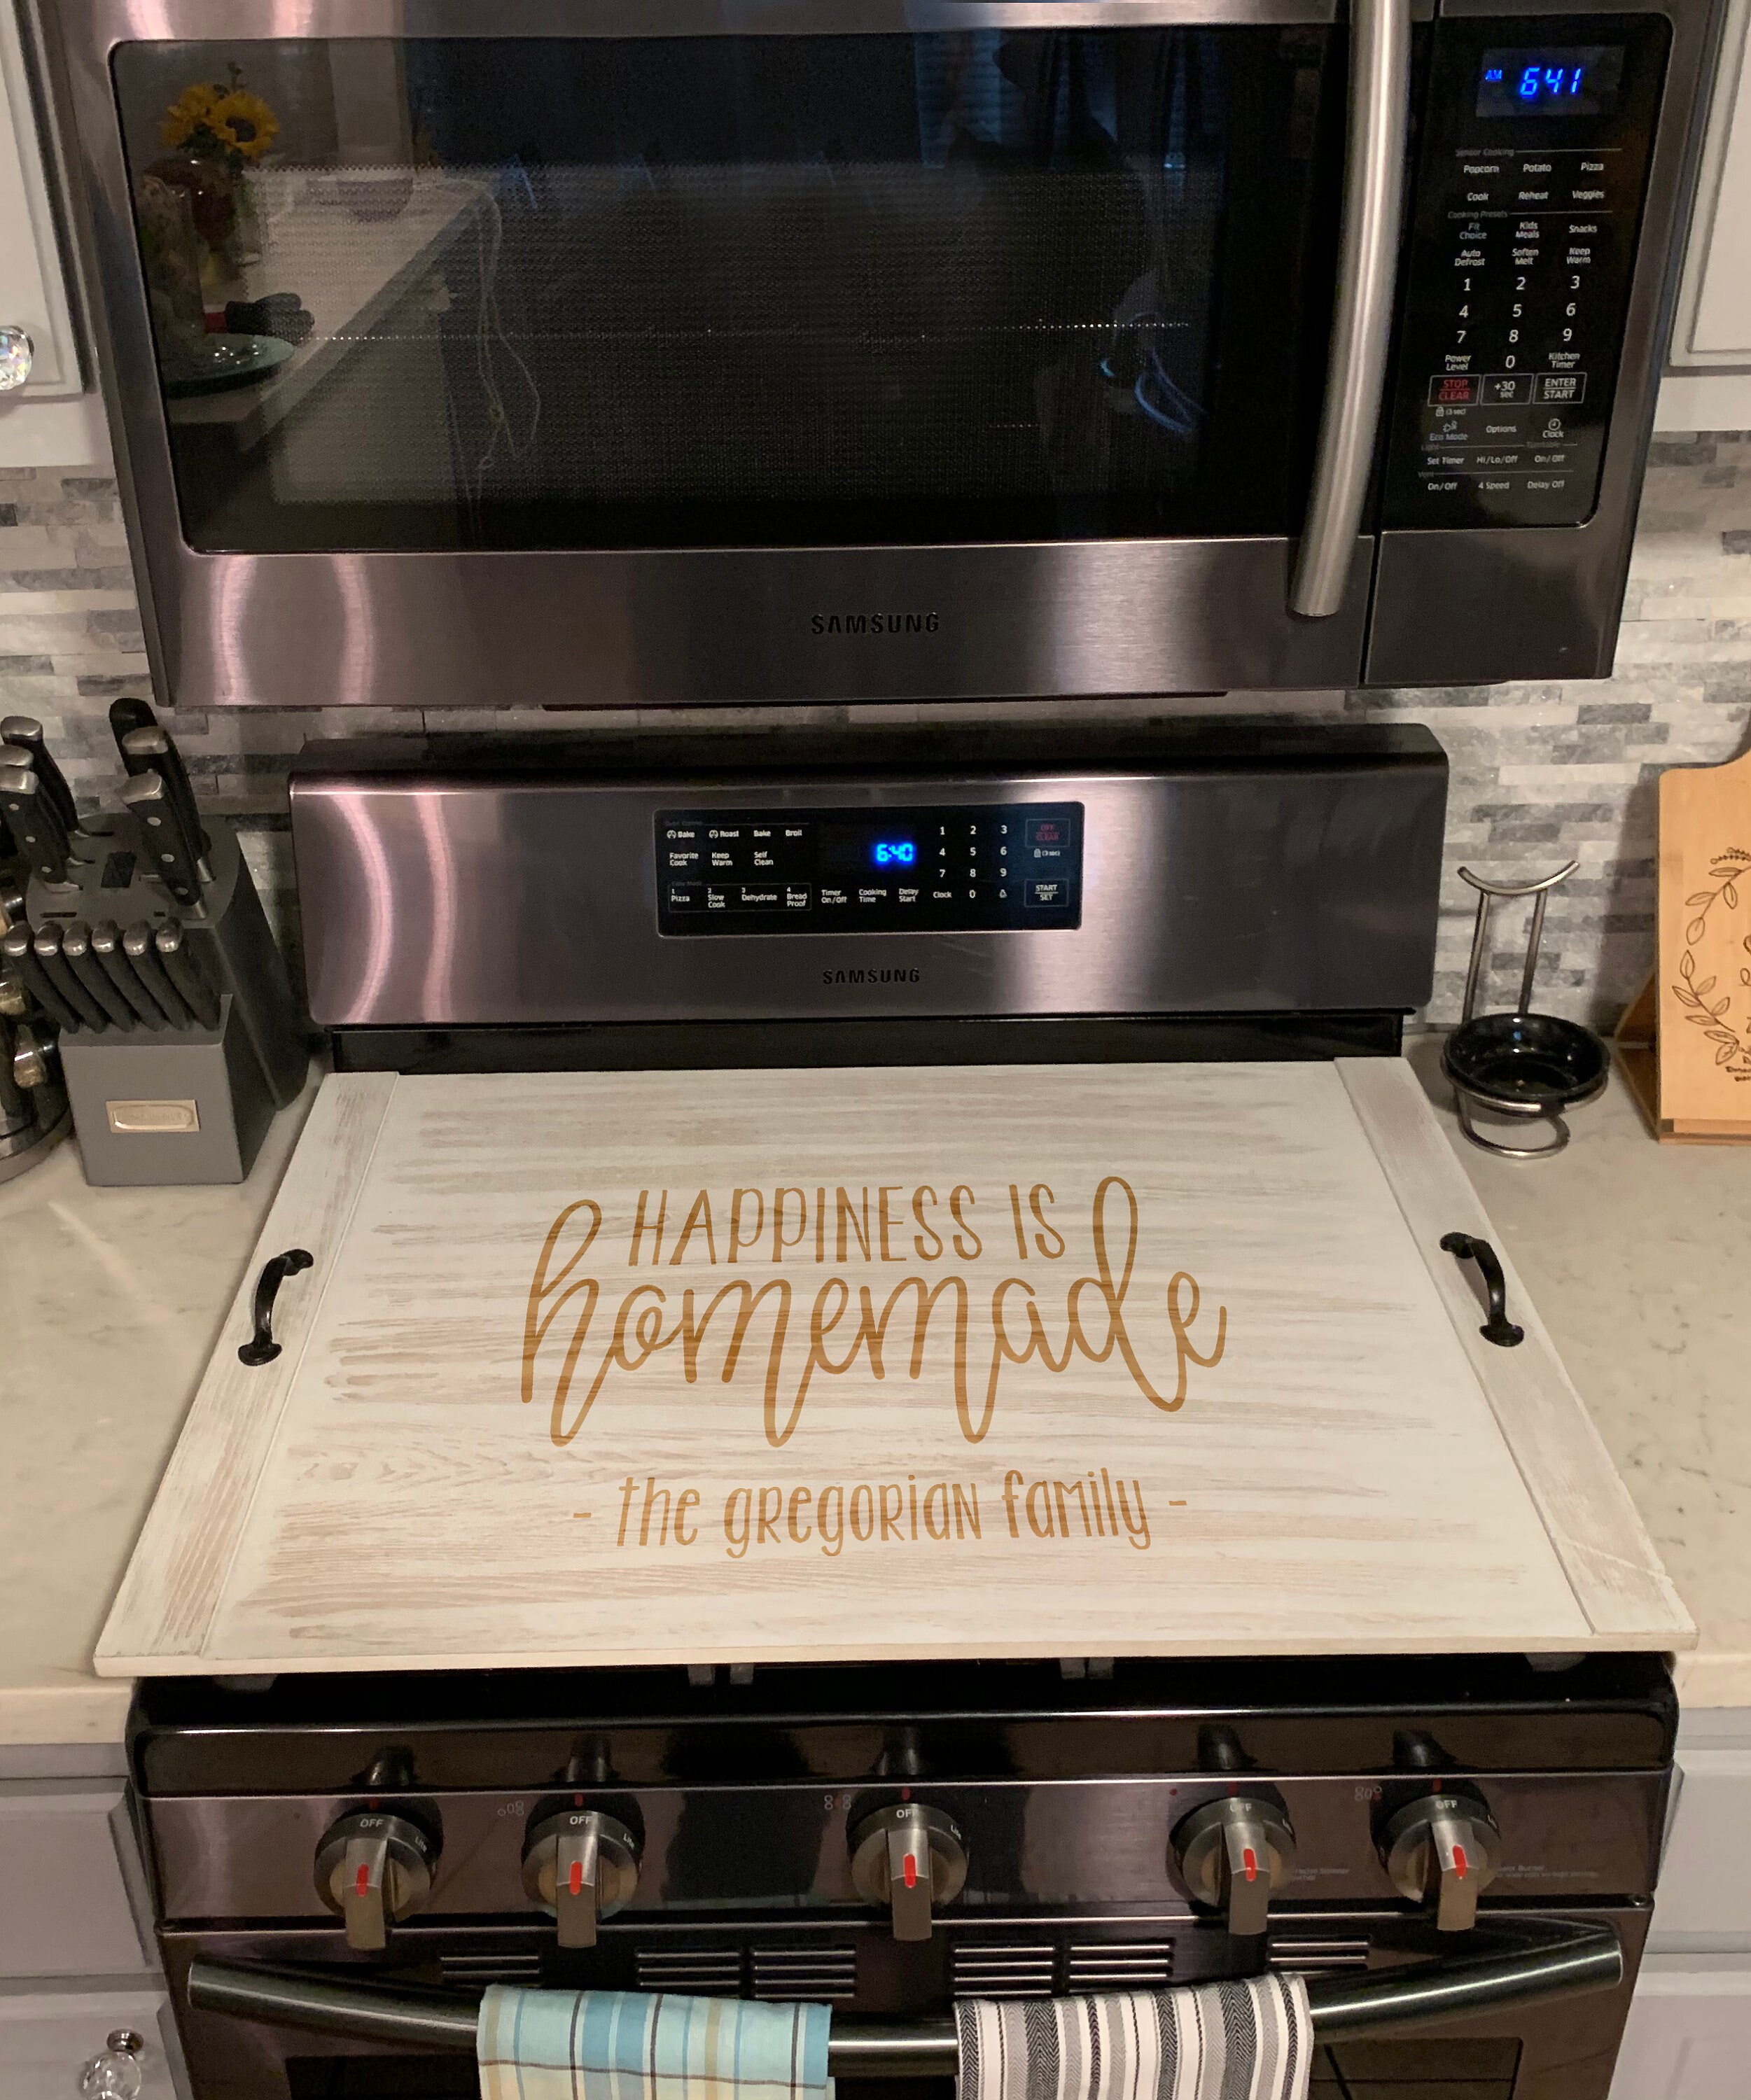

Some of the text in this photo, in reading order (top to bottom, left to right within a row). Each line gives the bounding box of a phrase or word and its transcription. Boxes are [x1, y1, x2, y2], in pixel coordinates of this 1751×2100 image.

[1520, 67, 1581, 95] 641
[1463, 165, 1500, 174] Popcorn
[1523, 164, 1551, 172] Potato
[1581, 162, 1604, 171] Pizza
[1467, 192, 1489, 201] Cook
[1518, 191, 1549, 200] Reheat
[1572, 190, 1605, 200] Veggies
[1519, 221, 1538, 230] Kids
[1569, 224, 1598, 233] Snacks
[1459, 231, 1487, 239] Choice
[1515, 230, 1540, 239] Meals
[1512, 248, 1539, 257] Soften
[1454, 258, 1485, 266] Defrost
[1464, 278, 1470, 291] 1
[1516, 276, 1526, 290] 2
[1570, 275, 1580, 289] 3
[1459, 304, 1469, 318] 4
[1512, 304, 1522, 317] 5
[1566, 302, 1576, 316] 6
[1457, 330, 1466, 344] 7
[1509, 330, 1519, 342] 8
[1563, 328, 1572, 341] 9
[1549, 352, 1580, 360] Kitchen
[1505, 356, 1515, 368] 0
[1446, 363, 1469, 371] Level
[1444, 379, 1467, 388] STOP
[1494, 381, 1515, 391] +30
[1545, 378, 1576, 387] ENTER
[1439, 391, 1469, 400] CLEAR
[1544, 390, 1575, 399] START
[811, 612, 939, 634] SAMSUNG
[940, 826, 945, 835] 1
[970, 825, 976, 834] 2
[1000, 825, 1007, 834] 3
[877, 844, 913, 862] 6:40
[940, 848, 945, 856] 4
[970, 847, 976, 856] 5
[1000, 846, 1007, 855] 6
[940, 869, 945, 878] 7
[970, 868, 976, 877] 8
[1000, 868, 1007, 877] 9
[969, 890, 975, 899] 0
[823, 969, 920, 984] SAMSUNG
[628, 1183, 1066, 1267] HAPPINESS IS
[520, 1176, 1227, 1448] homemade
[617, 1476, 701, 1546] the
[723, 1474, 981, 1558] gregorian
[1002, 1467, 1151, 1550] family
[1436, 1800, 1458, 1809] OFF
[361, 1819, 383, 1828] OFF
[569, 1816, 591, 1825] OFF
